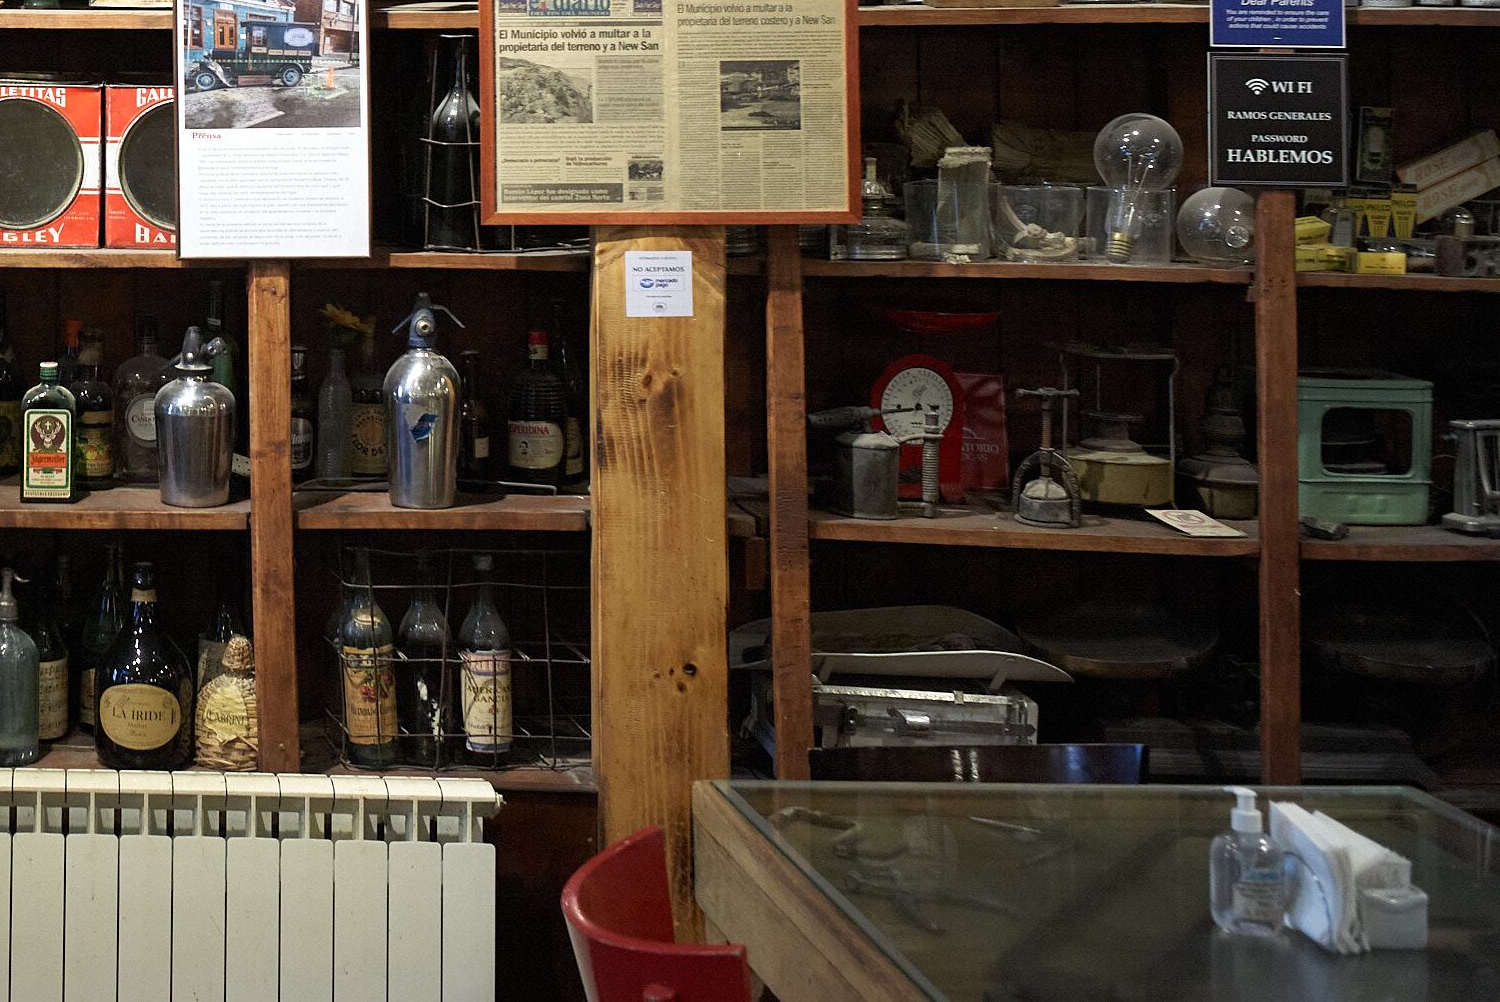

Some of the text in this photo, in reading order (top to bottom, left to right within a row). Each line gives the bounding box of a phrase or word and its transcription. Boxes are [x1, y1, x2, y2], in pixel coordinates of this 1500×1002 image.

[499, 28, 651, 40] El Municipio volvió a multar a la
[499, 40, 659, 54] propietaria del terreno y a New San
[1271, 81, 1313, 94] WI FI
[1227, 110, 1332, 121] RAMOS GENERALES
[1251, 134, 1308, 143] PASSWORD
[1227, 149, 1333, 164] HABLEMOS
[112, 707, 166, 722] LA IRIDE
